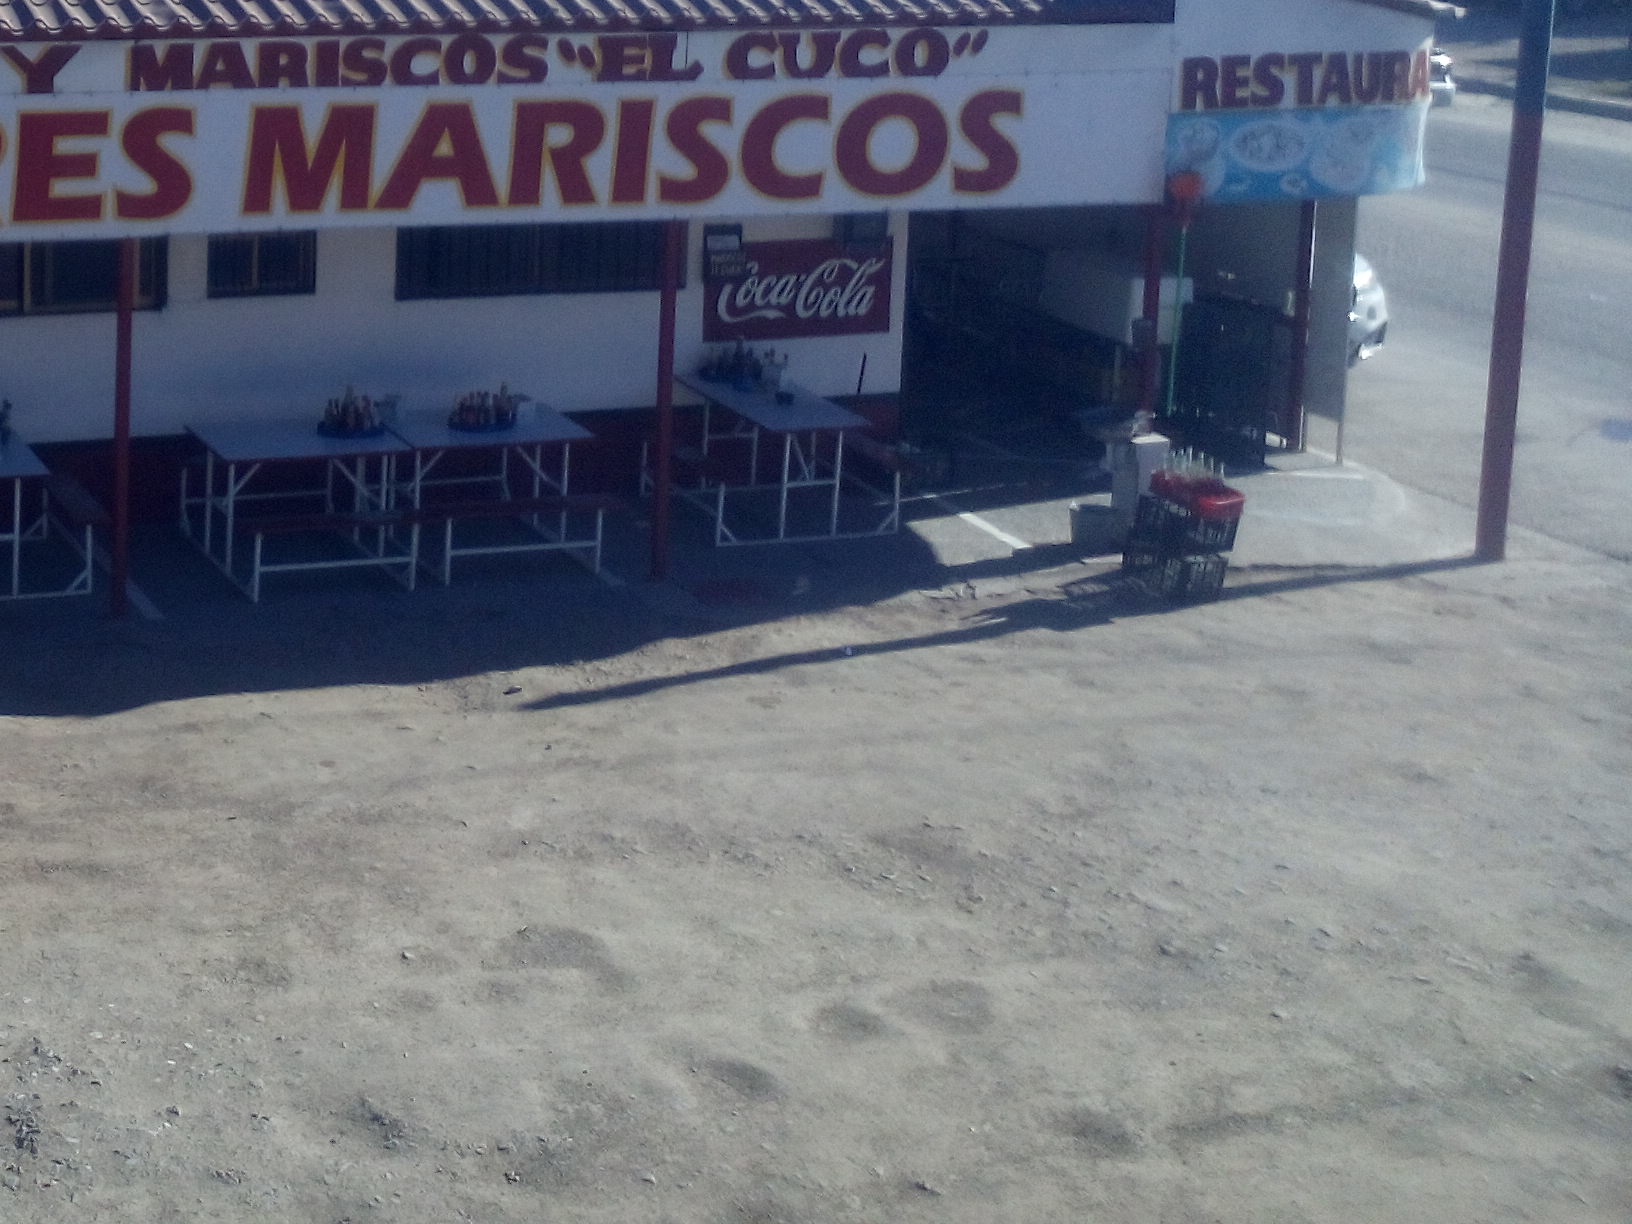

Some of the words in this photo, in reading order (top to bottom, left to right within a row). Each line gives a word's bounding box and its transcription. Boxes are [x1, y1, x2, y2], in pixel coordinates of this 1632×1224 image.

[0, 44, 81, 94] Y
[128, 33, 549, 91] MARISCOS
[240, 90, 1023, 215] MARISCOS
